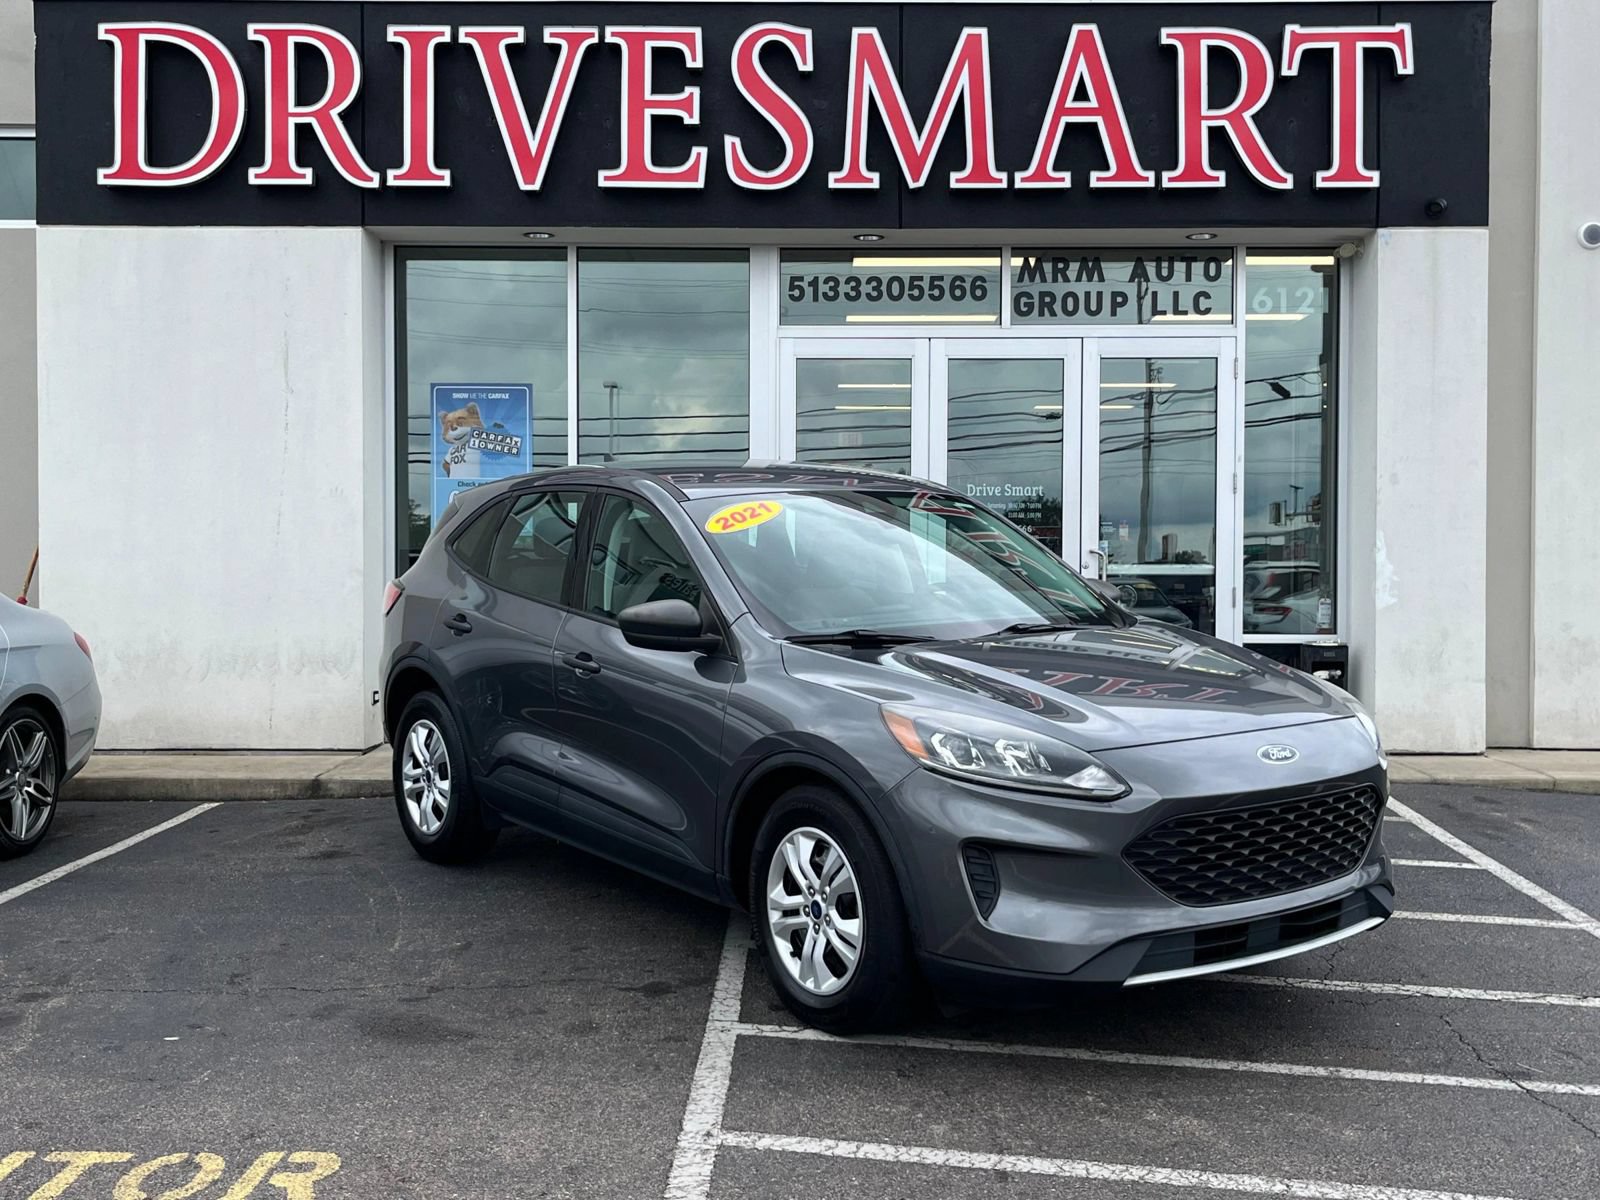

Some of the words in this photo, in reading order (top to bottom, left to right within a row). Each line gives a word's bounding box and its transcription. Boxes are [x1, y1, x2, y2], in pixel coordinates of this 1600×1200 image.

[97, 21, 1414, 191] DRIVESMART
[1017, 256, 1106, 283] MRM
[1128, 256, 1222, 283] AUTO
[788, 275, 988, 303] 5133305566
[1013, 291, 1129, 317] GROUP
[1152, 291, 1212, 316] LLC
[1252, 287, 1329, 313] 6121
[452, 392, 469, 400] SHOW
[488, 392, 510, 400] CARFAX
[473, 430, 521, 447] CARFAX
[450, 444, 466, 456] CAR
[450, 454, 466, 465] FOX
[457, 480, 476, 488] Check
[967, 483, 1001, 497] Drive
[1004, 483, 1044, 497] Smart
[715, 502, 774, 531] 2021
